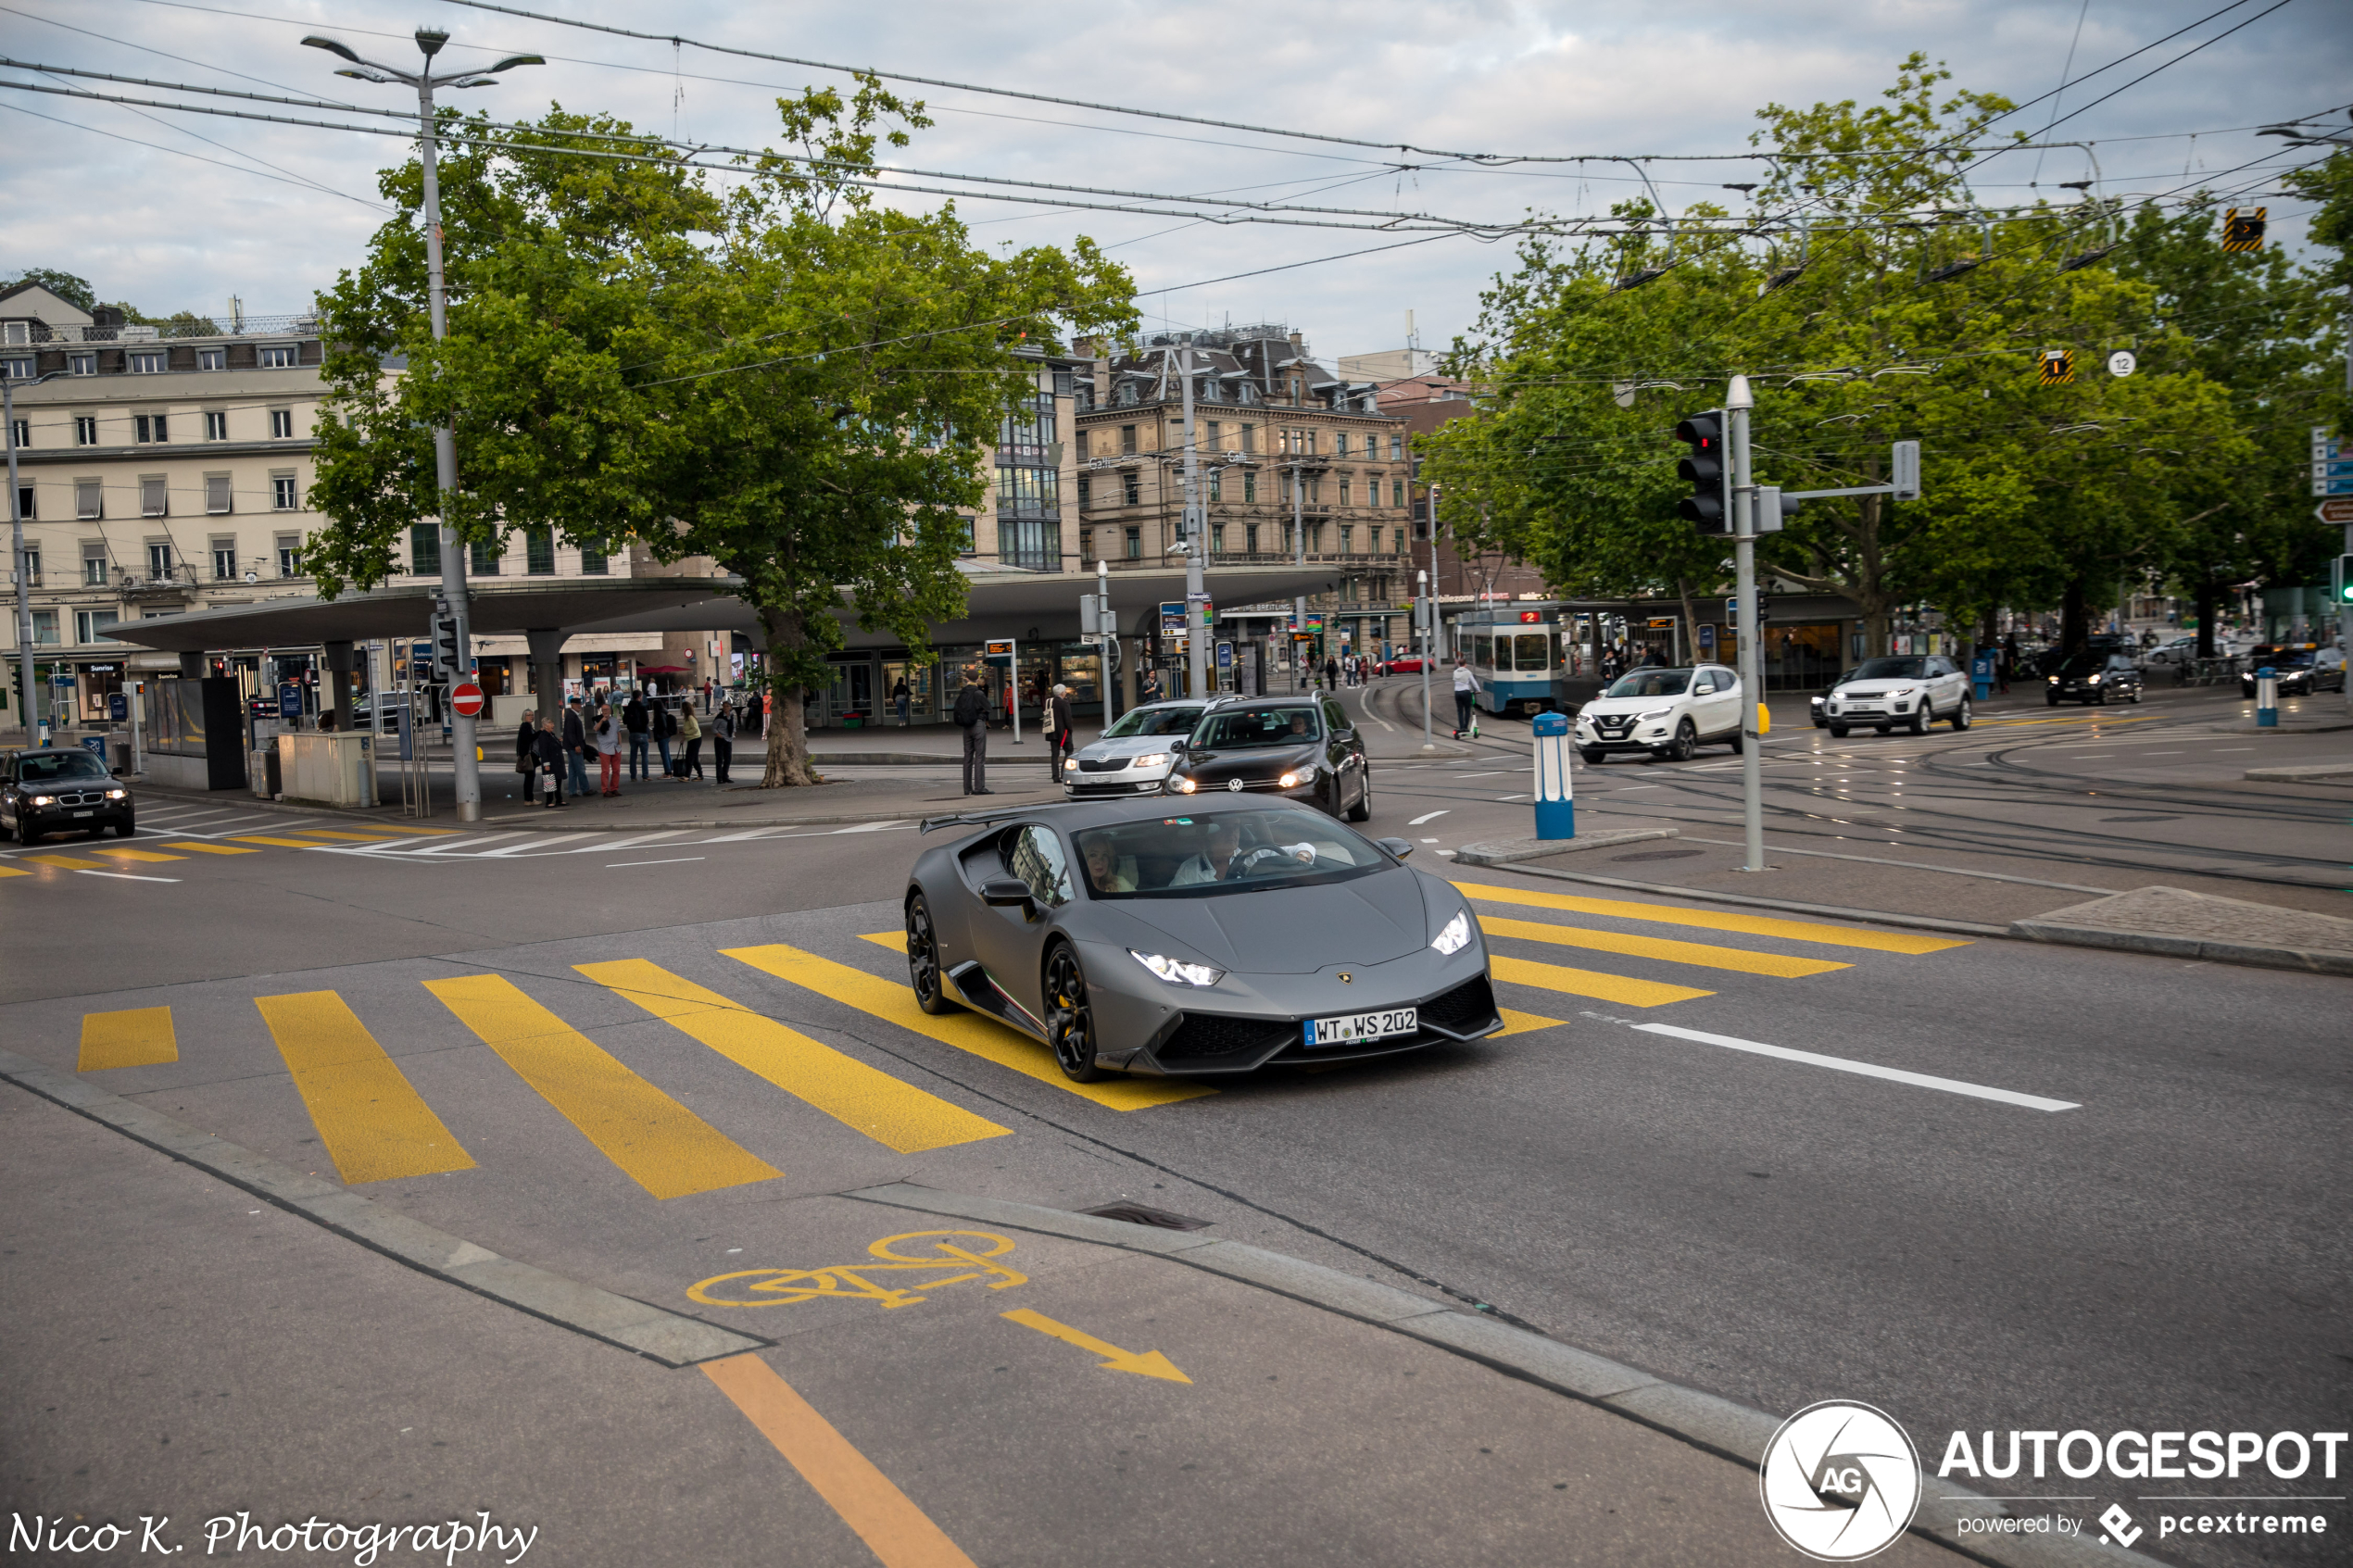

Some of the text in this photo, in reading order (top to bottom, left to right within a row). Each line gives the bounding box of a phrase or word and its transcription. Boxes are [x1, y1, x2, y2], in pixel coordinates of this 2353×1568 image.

[2115, 358, 2130, 370] 12
[1428, 594, 1475, 604] mbilezone
[1257, 603, 1290, 611] BREITLING
[1527, 612, 1535, 622] 2
[1316, 1021, 1340, 1041] WT
[1353, 1015, 1378, 1036] WS
[1382, 1010, 1416, 1033] 202
